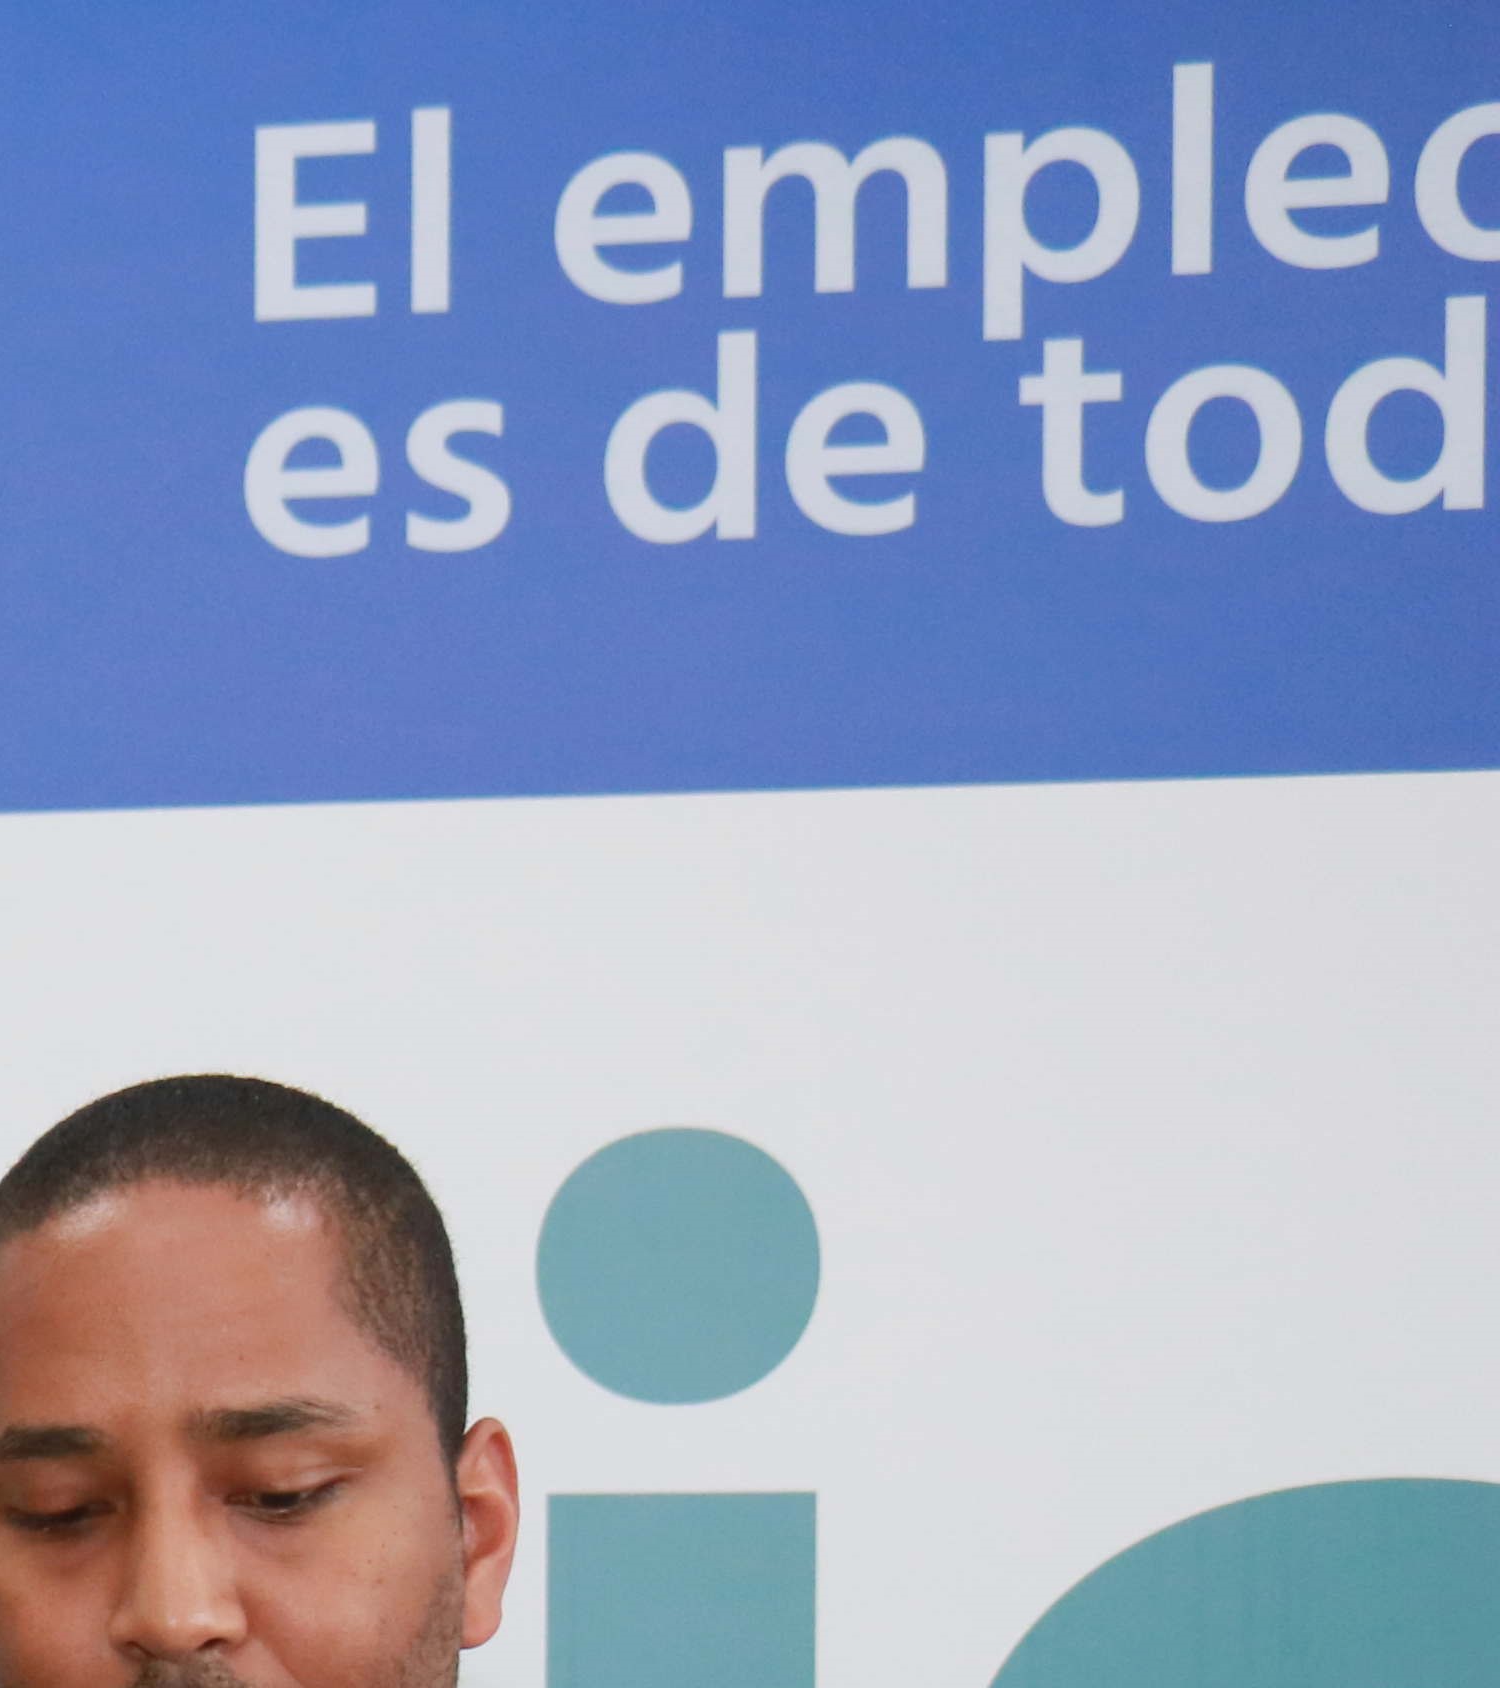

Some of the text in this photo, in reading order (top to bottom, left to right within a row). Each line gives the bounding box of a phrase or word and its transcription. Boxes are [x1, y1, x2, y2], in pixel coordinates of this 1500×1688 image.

[253, 106, 452, 322] El
[243, 399, 512, 559] es
[603, 329, 926, 545] de
